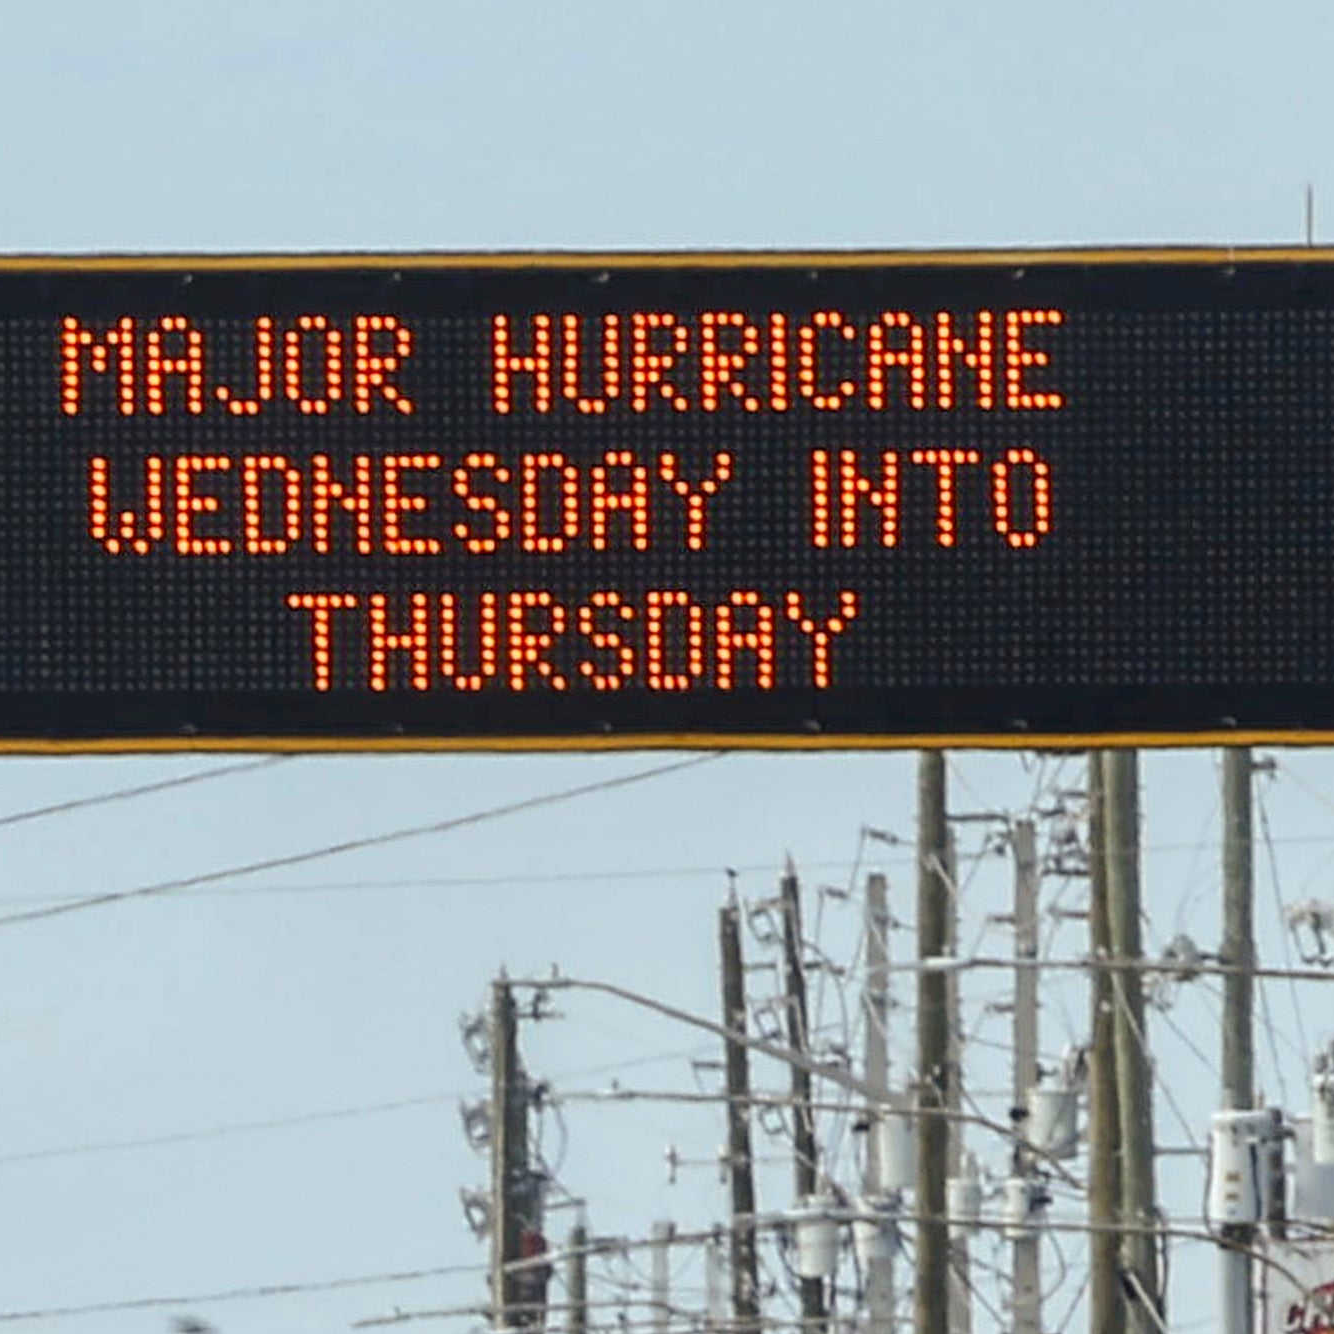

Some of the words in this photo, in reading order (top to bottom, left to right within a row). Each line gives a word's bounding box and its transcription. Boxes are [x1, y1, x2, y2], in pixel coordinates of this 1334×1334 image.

[60, 315, 413, 416] MAJOR
[492, 309, 1064, 415] HURRICANE
[89, 450, 732, 556] WEDNESDAY
[811, 448, 1051, 549] INTO
[286, 590, 858, 692] THURSDAY
